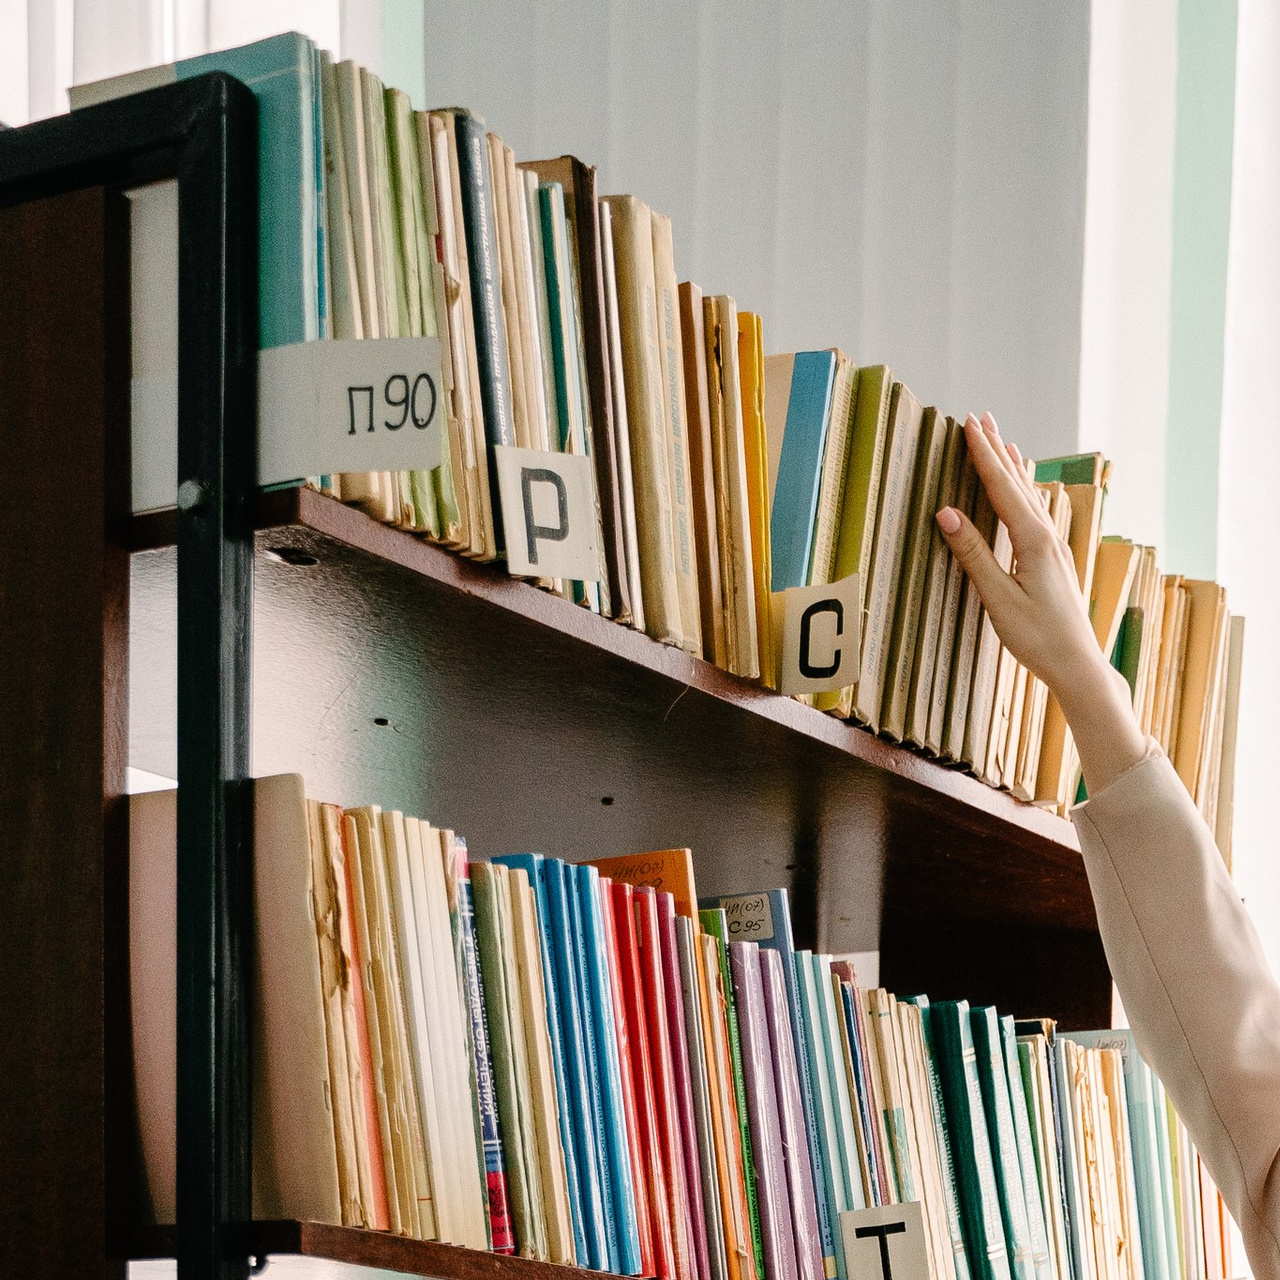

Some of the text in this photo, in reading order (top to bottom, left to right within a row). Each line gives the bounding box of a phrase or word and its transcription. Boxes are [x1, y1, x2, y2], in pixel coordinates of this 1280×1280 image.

[471, 137, 501, 378] ПРЕПОДАВАНИЯ ИНОСТРАННЫХ ЯЗЫКОВ
[660, 288, 692, 574] МЕТОДИКА ОБУЧЕНИЯ ИНОСТРАННЫМ ЯЗЫКАМ
[519, 467, 570, 565] Р
[799, 598, 844, 679] С
[866, 637, 876, 676] ОЧЕРКИ
[464, 935, 493, 1115] И МЕТОДЫ ОБУЧЕНИЯ
[933, 1073, 963, 1219] ИНОСТРАННЫМ ЯЗЫКАМ
